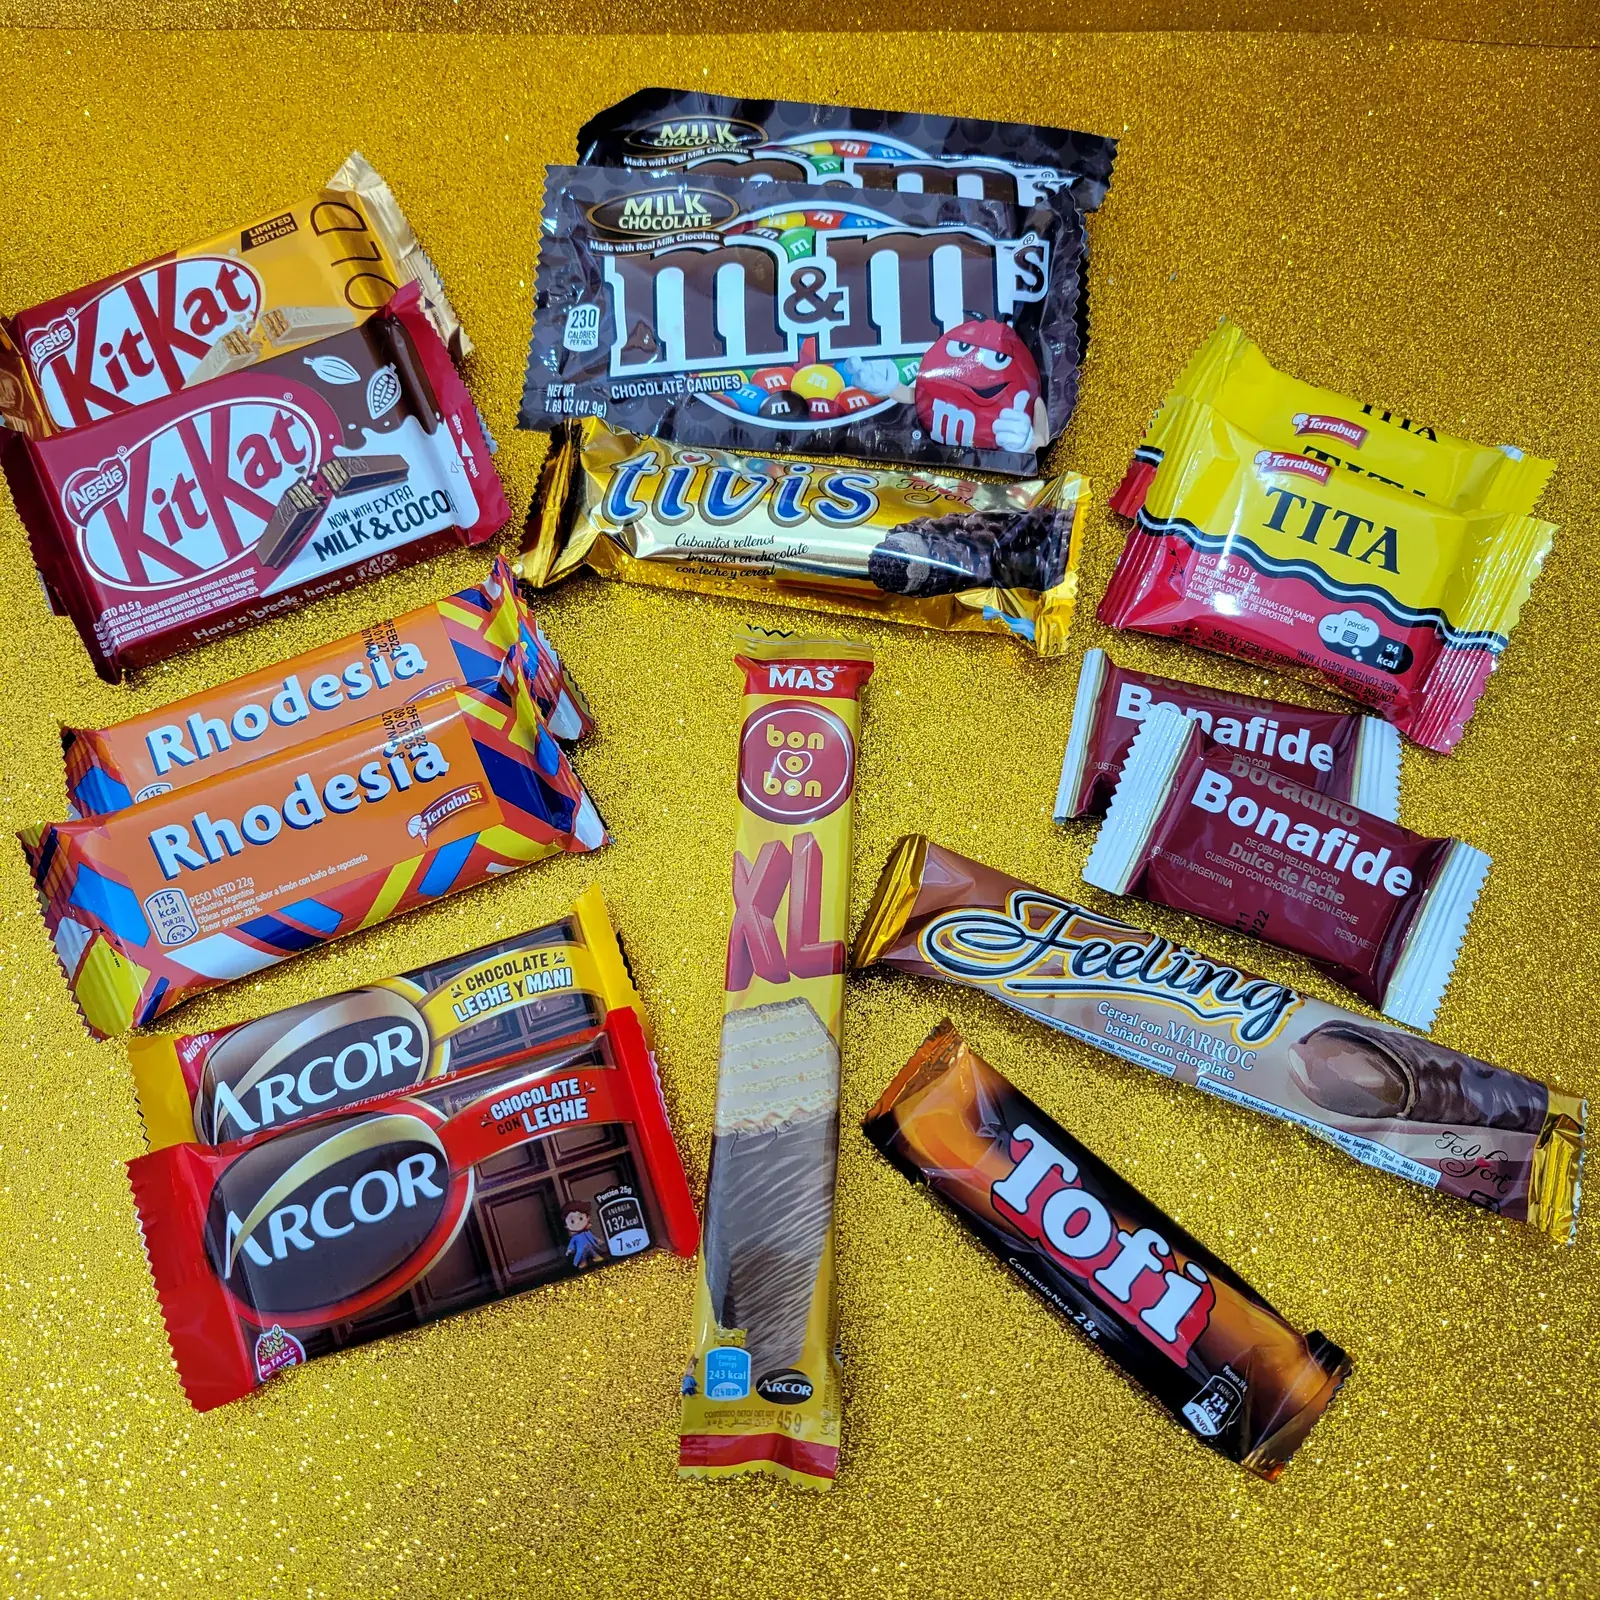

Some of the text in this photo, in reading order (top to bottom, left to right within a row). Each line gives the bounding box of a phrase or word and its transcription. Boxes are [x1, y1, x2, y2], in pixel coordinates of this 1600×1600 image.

[623, 156, 647, 167] Made
[648, 156, 667, 166] with
[668, 154, 686, 164] Real
[624, 193, 709, 216] MILK
[249, 215, 292, 238] LIMITED
[250, 223, 296, 247] EDITION
[618, 213, 712, 231] CHOCOLATE
[589, 231, 720, 252] Made with Real Milk Chocolate
[570, 309, 597, 329] 230
[50, 262, 252, 427] KitKat
[567, 329, 597, 341] CALORIES
[569, 338, 579, 346] PER
[546, 383, 563, 398] NET
[611, 374, 742, 400] CHOCOLATE CANDIES
[763, 374, 788, 389] m
[544, 399, 608, 418] 1.69 OZ (47.9g)
[931, 398, 976, 448] m
[1271, 451, 1328, 478] Terrabusi
[69, 464, 124, 511] Nestlé
[102, 406, 307, 585] KitKat
[602, 452, 880, 528] tivis
[326, 484, 415, 530] NOW WITH EXTRA
[311, 519, 371, 562] MILK
[371, 514, 396, 541] &
[675, 532, 775, 549] Cubanitos rellenos
[1262, 485, 1401, 575] TITA
[739, 543, 810, 564] en chocolate
[1198, 553, 1249, 578] PESO 19
[200, 576, 229, 592] CHOCOLATE
[675, 565, 776, 578] con cereal
[117, 600, 141, 614] 41,5 g
[193, 618, 234, 641] Have
[237, 614, 248, 624] a
[303, 577, 341, 599] have
[344, 573, 355, 583] a
[1185, 589, 1202, 601] Tenor
[144, 608, 196, 633] CON CHOCOLATE CON
[1248, 602, 1295, 626] DE REPOSTERÍA.
[1249, 593, 1278, 610] RELLENAS
[1278, 602, 1294, 616] CON
[1293, 610, 1315, 624] SABOR
[1349, 619, 1370, 633] porción
[1386, 643, 1399, 655] 94
[1376, 655, 1398, 670] kcal
[145, 642, 428, 776] Rhodesia
[766, 723, 825, 750] bon
[785, 755, 804, 773] o
[763, 771, 822, 798] bon
[147, 741, 451, 881] Rhodesia
[1190, 768, 1413, 897] Bonafide
[1228, 841, 1347, 906] Dulce de leche
[1243, 836, 1340, 886] DE OBLEA RELLENO CON
[197, 909, 220, 925] Obleas
[220, 905, 233, 916] con
[255, 889, 274, 903] sabor
[278, 879, 298, 894] limón
[297, 875, 310, 886] con
[309, 866, 327, 881] baño
[326, 863, 336, 874] de
[335, 851, 368, 873] repostería
[1186, 861, 1234, 889] ARGENTINA
[1204, 849, 1359, 926] CUBIERTO CON CHOCOLATE CON LECHE
[153, 893, 174, 909] 115
[189, 875, 255, 907] PESO NETO 22g
[194, 887, 254, 916] Industria Argentina
[157, 902, 180, 918] kcal
[162, 915, 186, 928] POR 22g
[200, 911, 244, 933] Tenor graso:
[724, 832, 848, 992] XL
[1334, 927, 1357, 944] PESO
[466, 953, 549, 991] CHOCOLATE
[925, 888, 1299, 1043] Feeling
[453, 967, 573, 1022] LECHE Y MANI
[1096, 999, 1257, 1071] Cereal con MARROC
[1086, 1033, 1173, 1071] size Amount per serving:
[1104, 1019, 1236, 1082] bañado con chocolate
[213, 1026, 421, 1145] ARCOR
[1199, 1078, 1279, 1115] Información Nutricional:
[490, 1078, 580, 1120] CHOCOLATE
[497, 1098, 589, 1136] CON LECHE
[596, 1185, 633, 1203] Porción 25g
[224, 1152, 444, 1280] ARCOR
[606, 1215, 640, 1234] 132 kcal
[616, 1238, 625, 1252] 7
[992, 1123, 1204, 1344] Tofi
[1008, 1255, 1075, 1316] Contenido Neto
[708, 1369, 747, 1380] 243 kcal
[757, 1379, 812, 1397] ARCOR
[1188, 1408, 1196, 1417] 7
[1198, 1396, 1223, 1424] kcal
[1208, 1391, 1229, 1414] 134
[776, 1409, 792, 1431] 45
[793, 1413, 802, 1434] g
